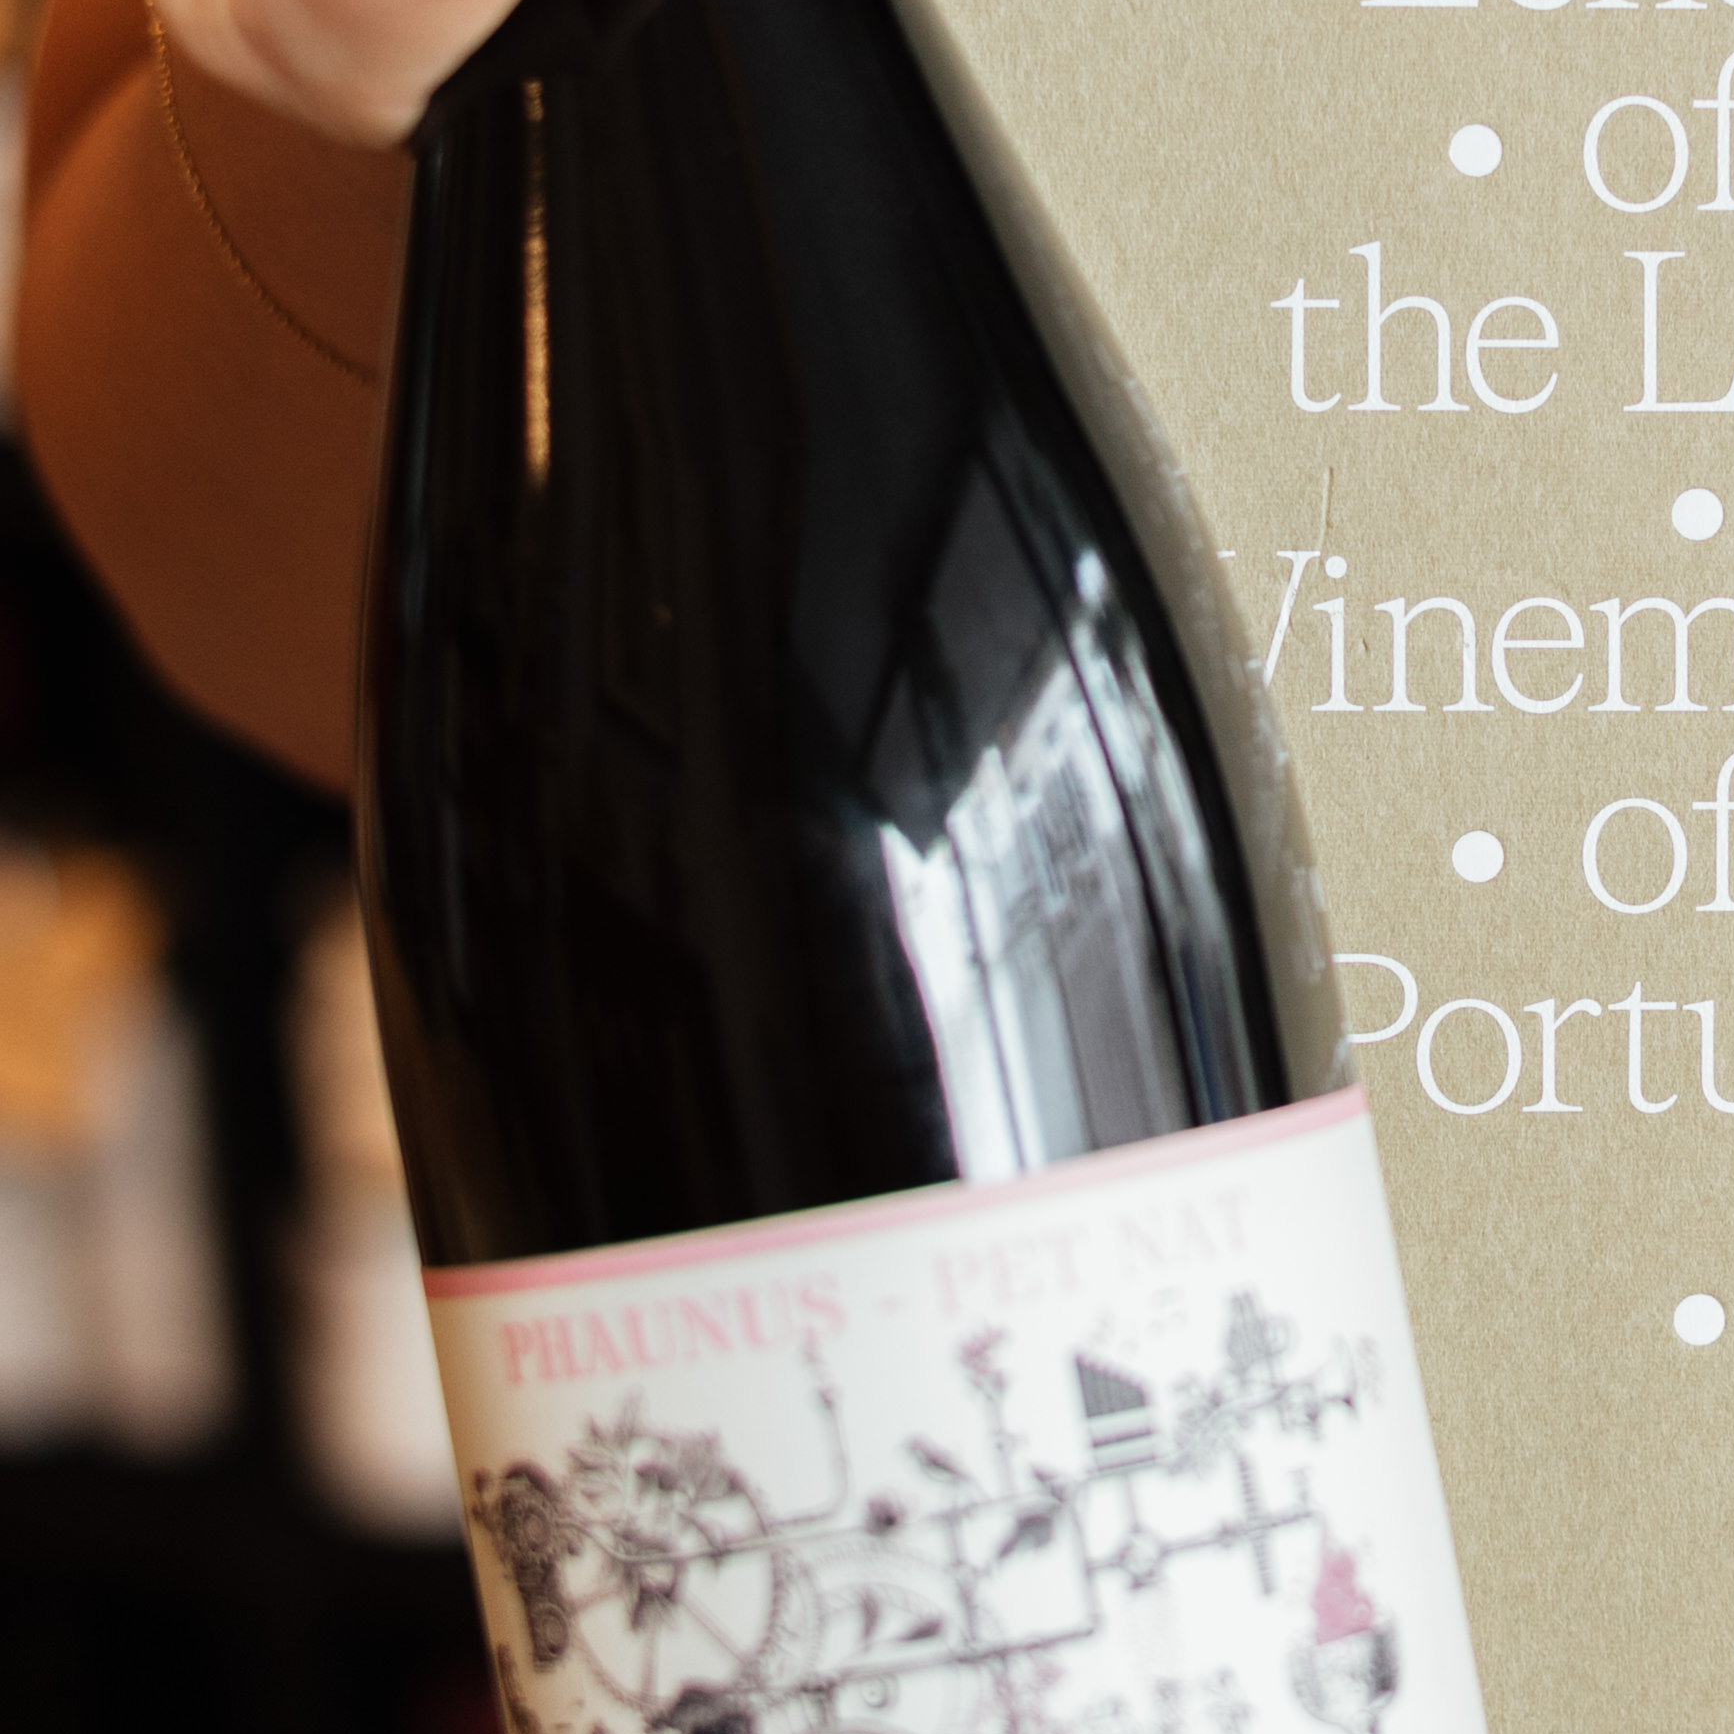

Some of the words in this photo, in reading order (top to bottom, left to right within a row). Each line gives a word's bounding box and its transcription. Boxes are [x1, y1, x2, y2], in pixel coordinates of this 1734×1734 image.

[1271, 242, 1560, 415] the
[502, 1274, 846, 1387] PHAUNUS
[933, 1224, 1086, 1326] PET
[1115, 1183, 1254, 1274] NAT
